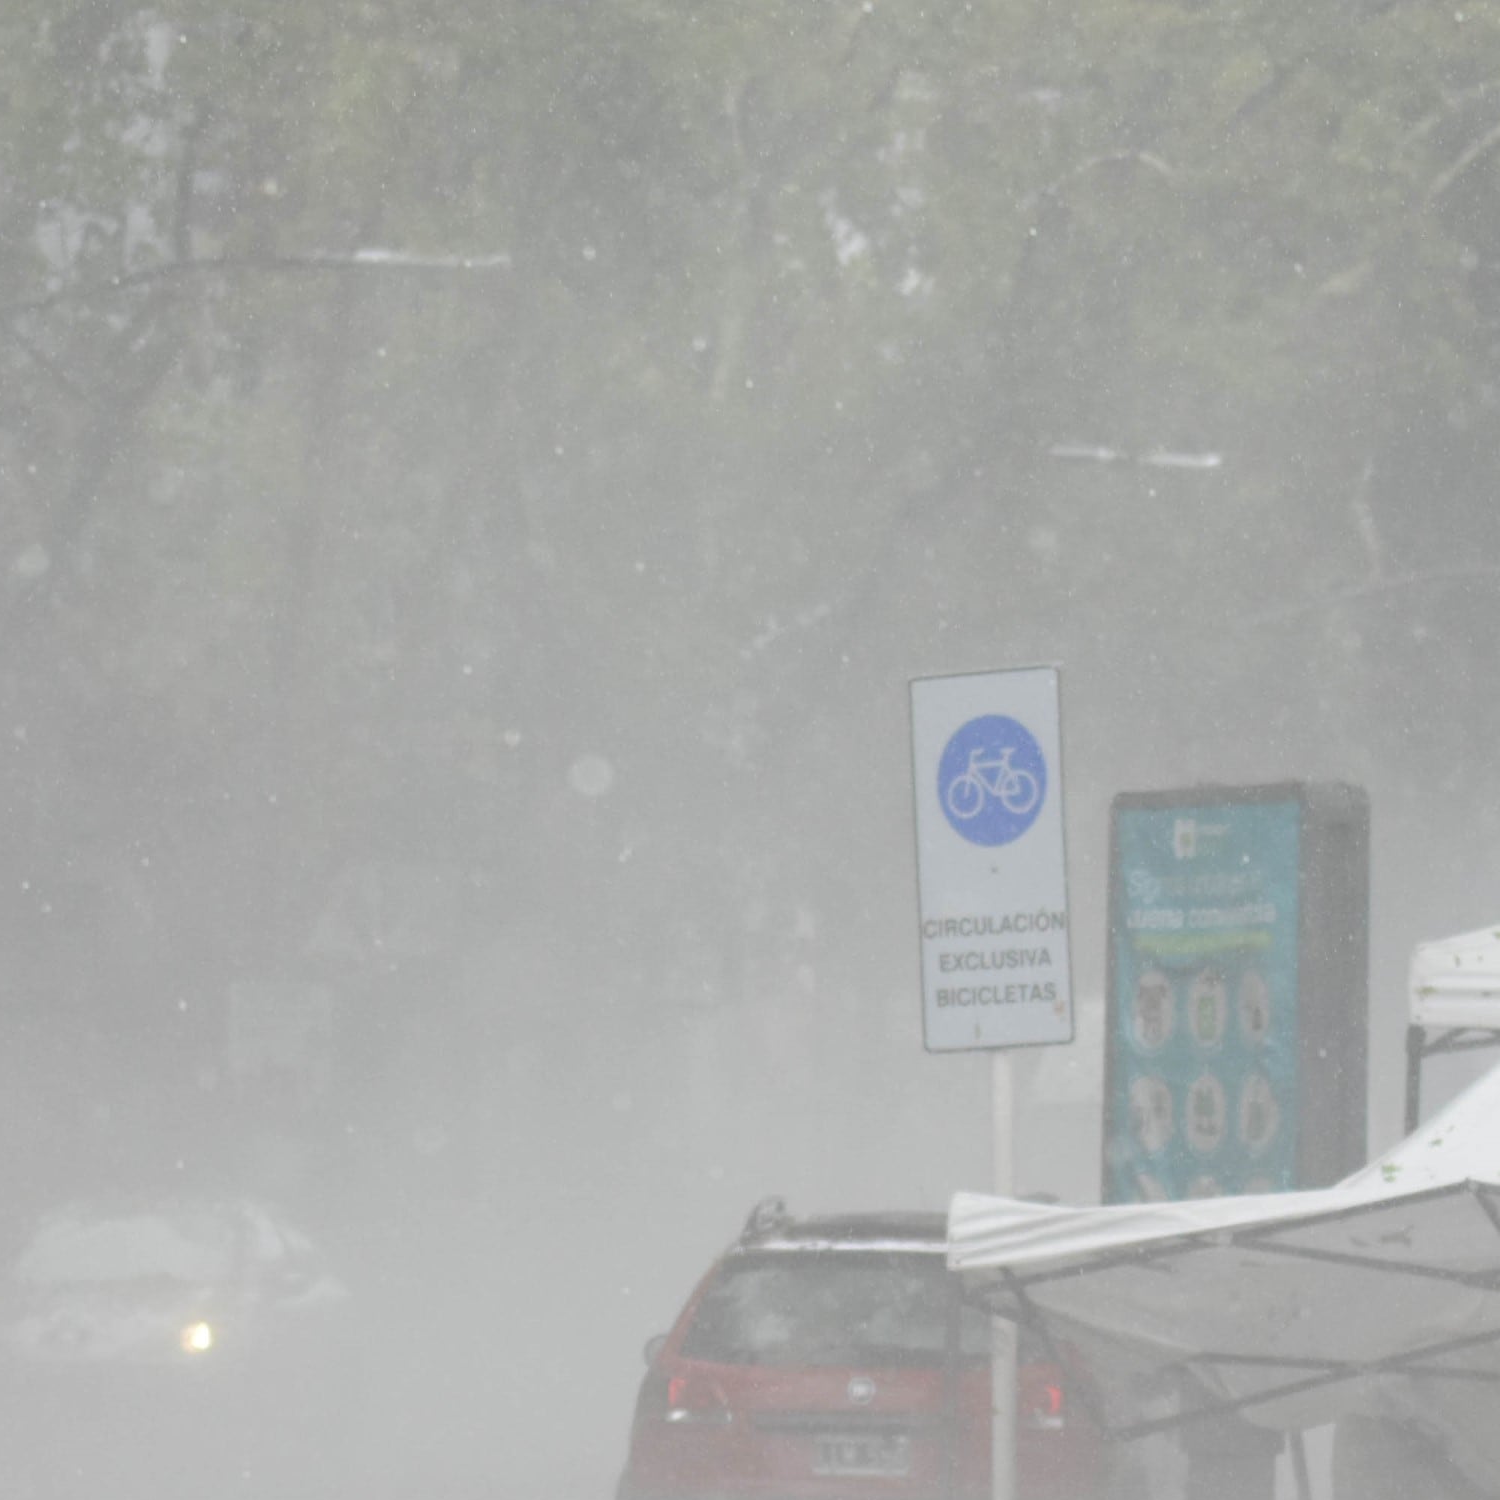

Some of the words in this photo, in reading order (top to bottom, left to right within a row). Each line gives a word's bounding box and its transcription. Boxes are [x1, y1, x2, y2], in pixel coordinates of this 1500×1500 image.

[923, 907, 1066, 939] CIRCULACIÓN
[938, 947, 1052, 972] EXCLUSIVA
[936, 981, 1058, 1008] BICICLETAS
